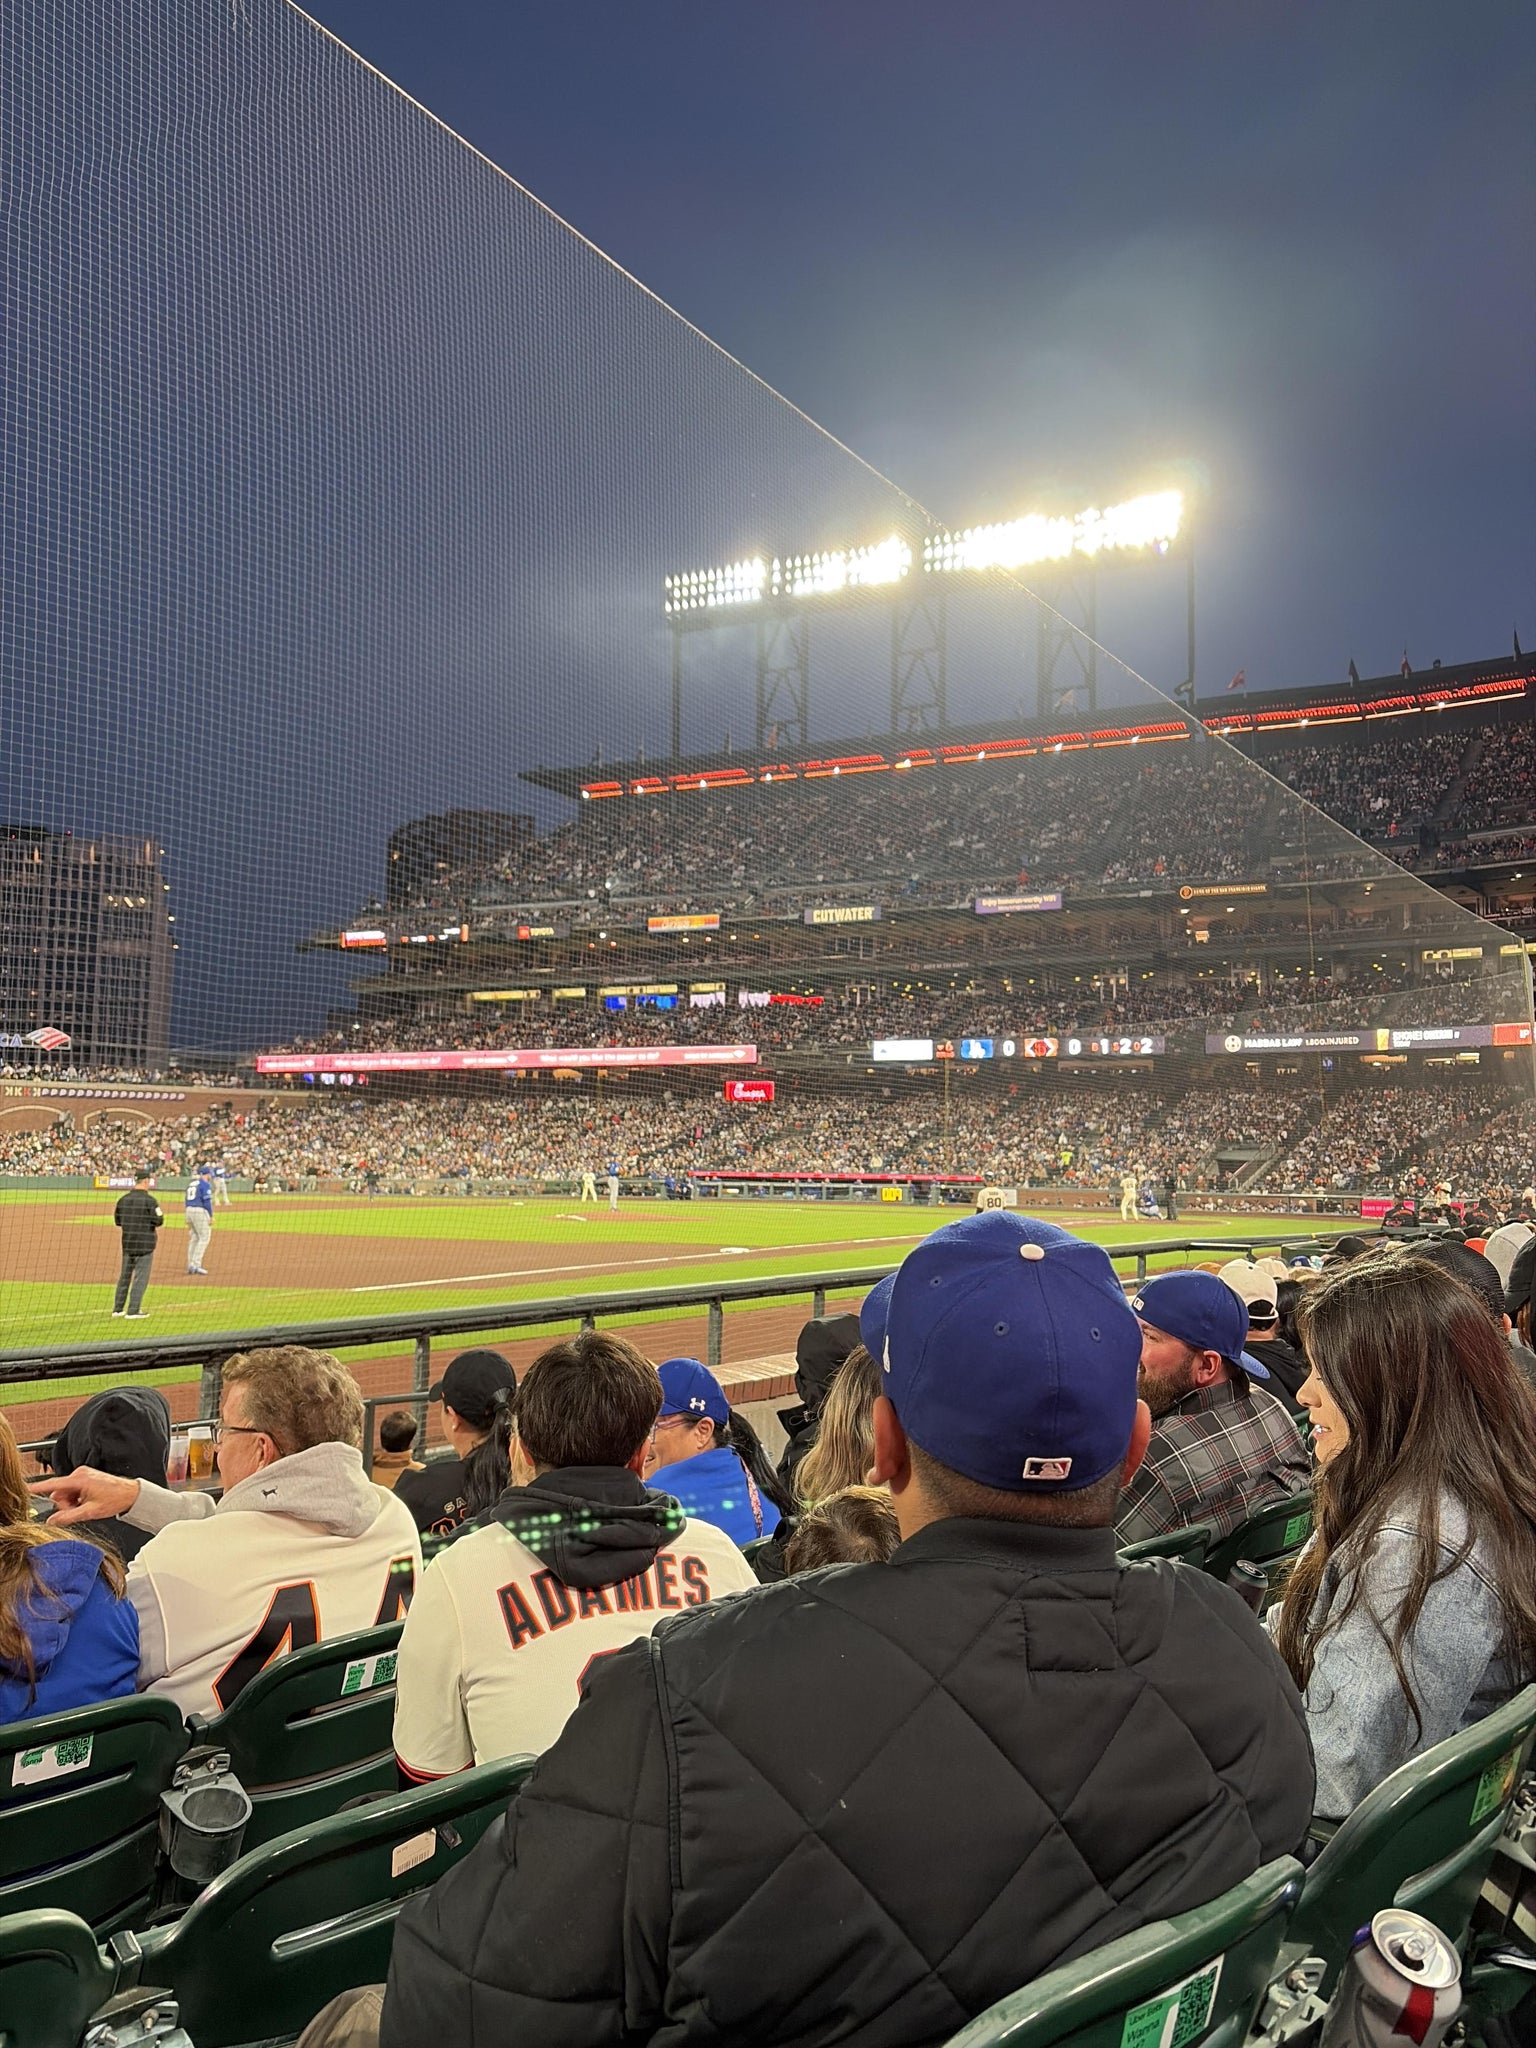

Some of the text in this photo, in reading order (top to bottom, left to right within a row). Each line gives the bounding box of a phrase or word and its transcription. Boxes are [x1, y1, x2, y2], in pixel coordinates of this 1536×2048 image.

[813, 906, 873, 923] CUTWATER
[1003, 1040, 1015, 1057] 0
[1068, 1039, 1081, 1055] 0
[1101, 1039, 1109, 1054] 1
[1120, 1038, 1132, 1054] 2
[1141, 1038, 1153, 1054] 2
[987, 1197, 1002, 1208] 80
[496, 1553, 711, 1650] ADAMES
[1126, 2019, 1160, 2044] Wanna
